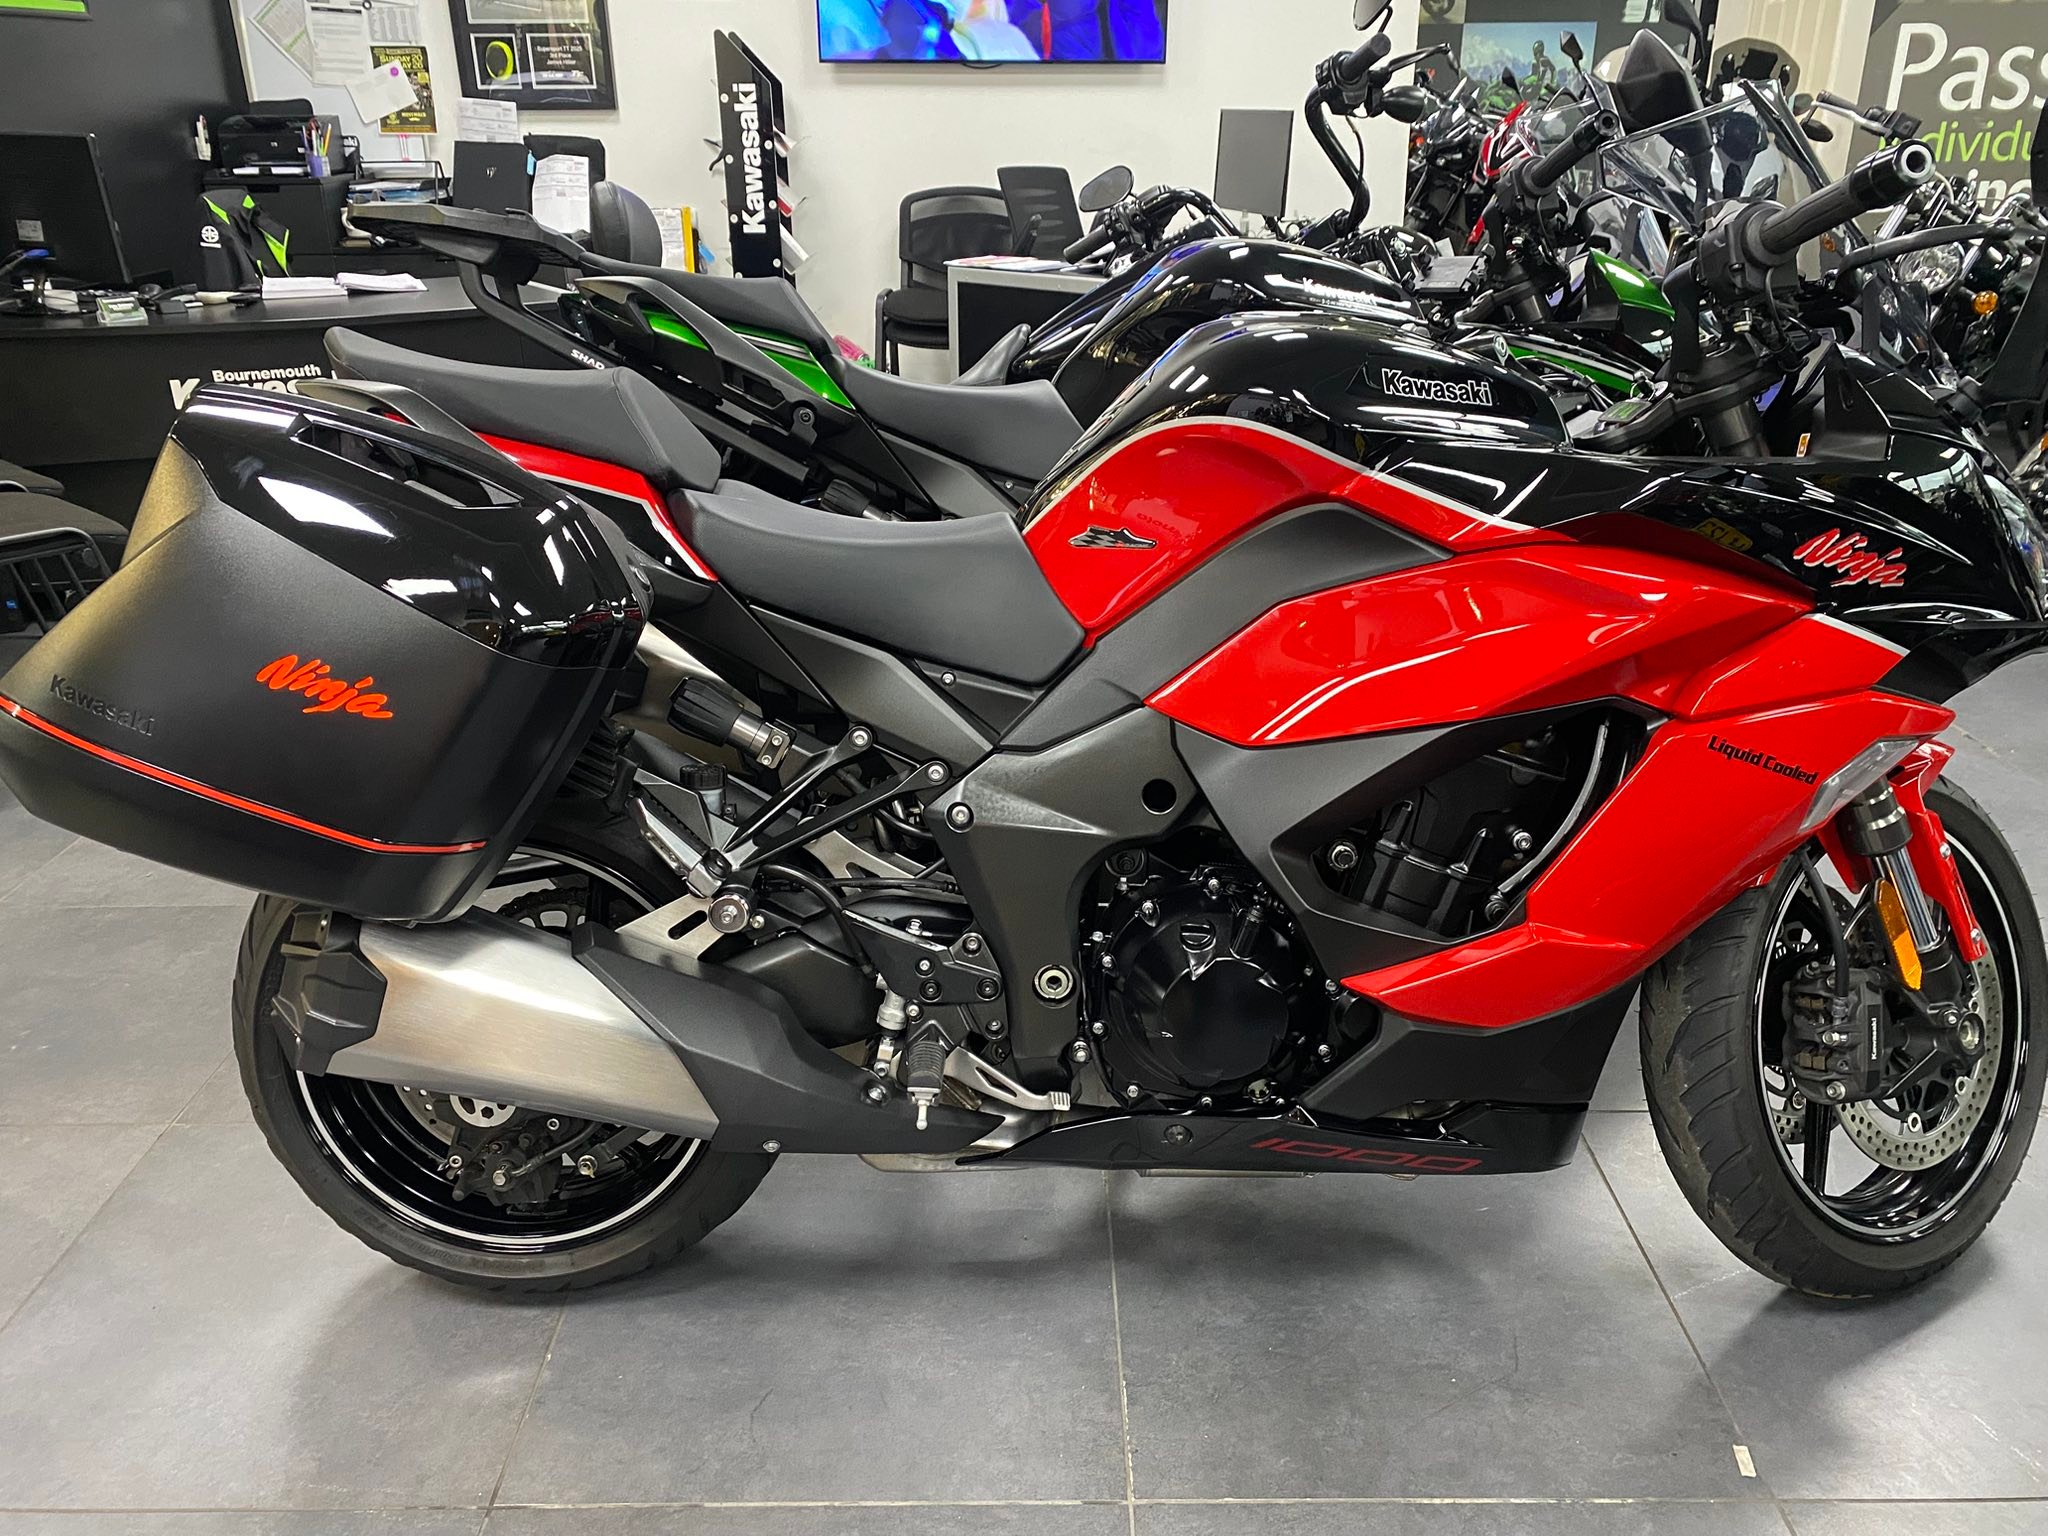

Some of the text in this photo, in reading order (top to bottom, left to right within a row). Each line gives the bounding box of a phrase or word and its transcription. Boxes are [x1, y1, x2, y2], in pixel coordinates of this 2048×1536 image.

[731, 82, 767, 235] Kawasaki
[211, 363, 322, 383] Bournemouth
[570, 349, 605, 370] SHAD
[1381, 367, 1493, 407] Kawasaki
[1793, 528, 1907, 588] Ninja
[48, 673, 156, 737] Kawasaki
[256, 653, 394, 720] Ninja
[1708, 735, 1819, 786] Liquid Cooled
[1250, 1137, 1483, 1172] 1000
